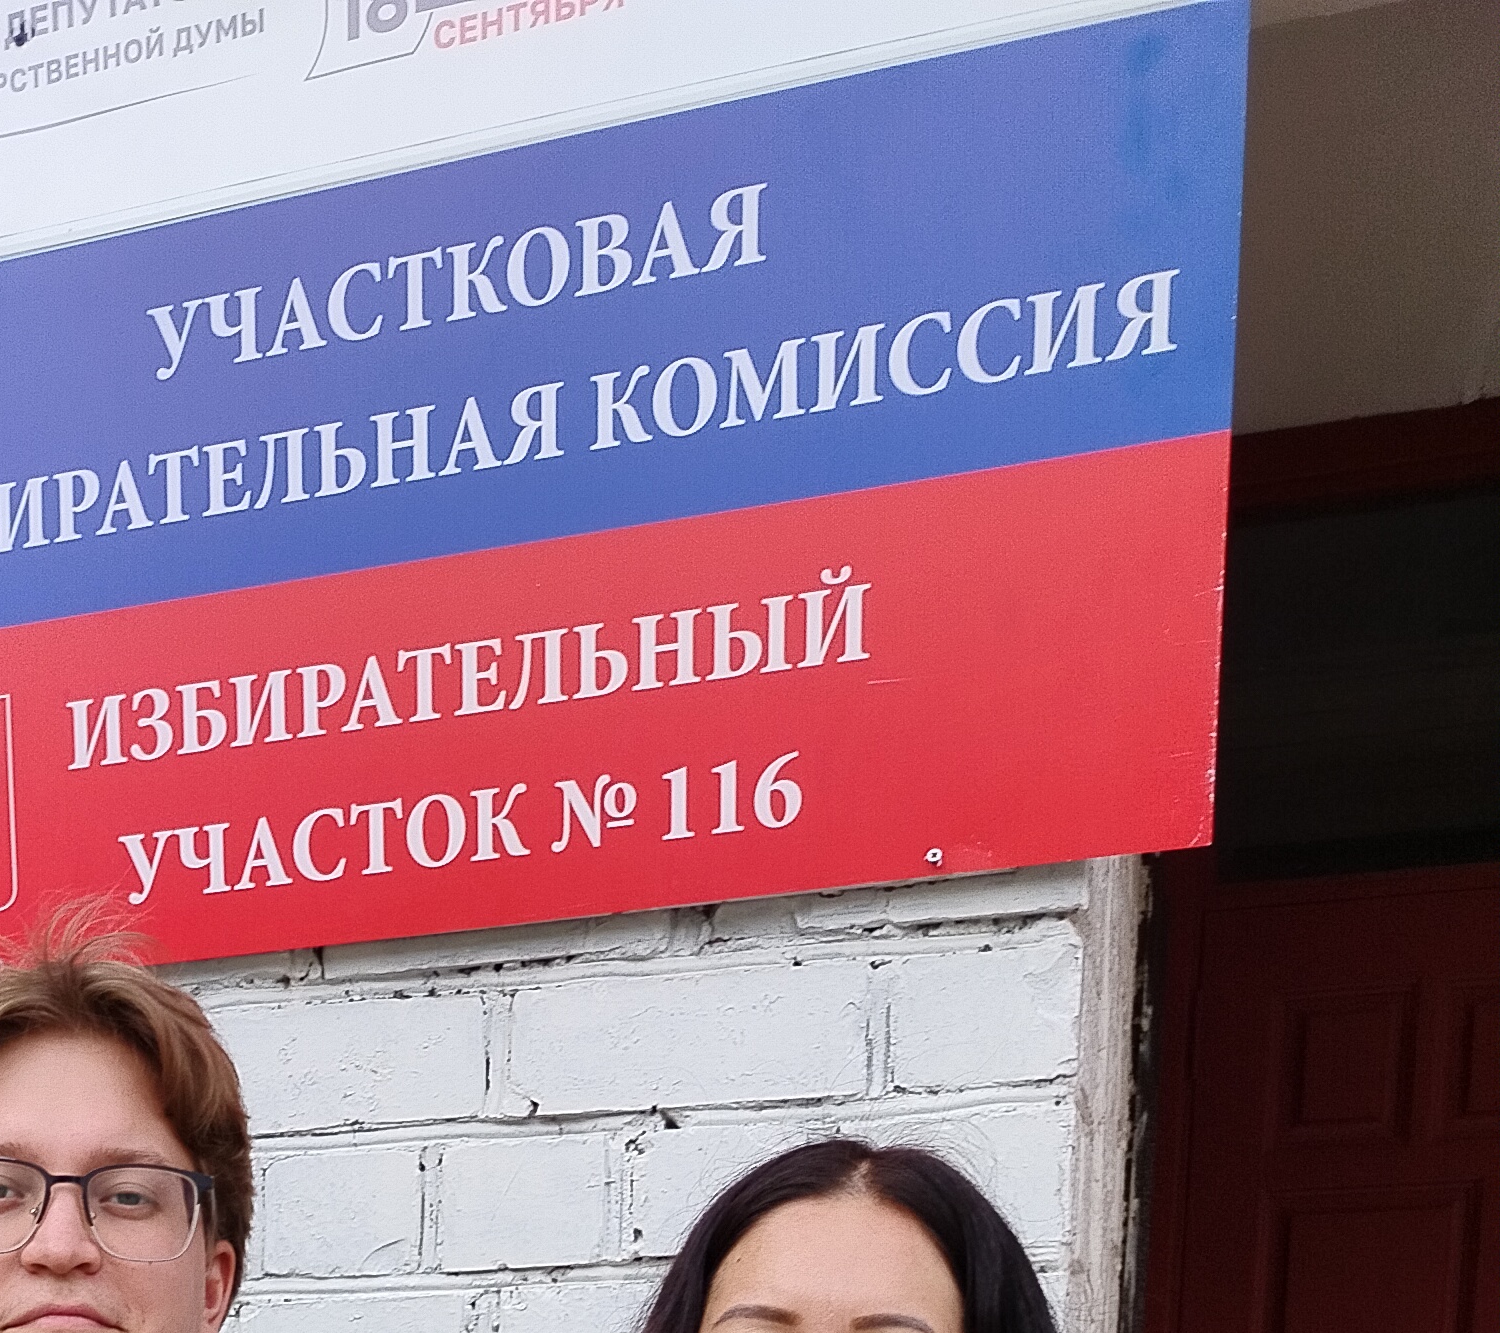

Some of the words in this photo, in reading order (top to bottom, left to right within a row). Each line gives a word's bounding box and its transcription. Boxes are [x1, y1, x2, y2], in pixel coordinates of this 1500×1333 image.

[173, 8, 266, 57] ДУМЫ
[146, 182, 768, 381] УЧАСТКОВАЯ
[590, 268, 1181, 451] КОМИССИЯ
[65, 564, 871, 771] ИЗБИРАТЕЛЬНЫЙ
[118, 783, 530, 905] УЧАСТОК
[551, 774, 638, 853] №
[660, 751, 804, 841] 116
